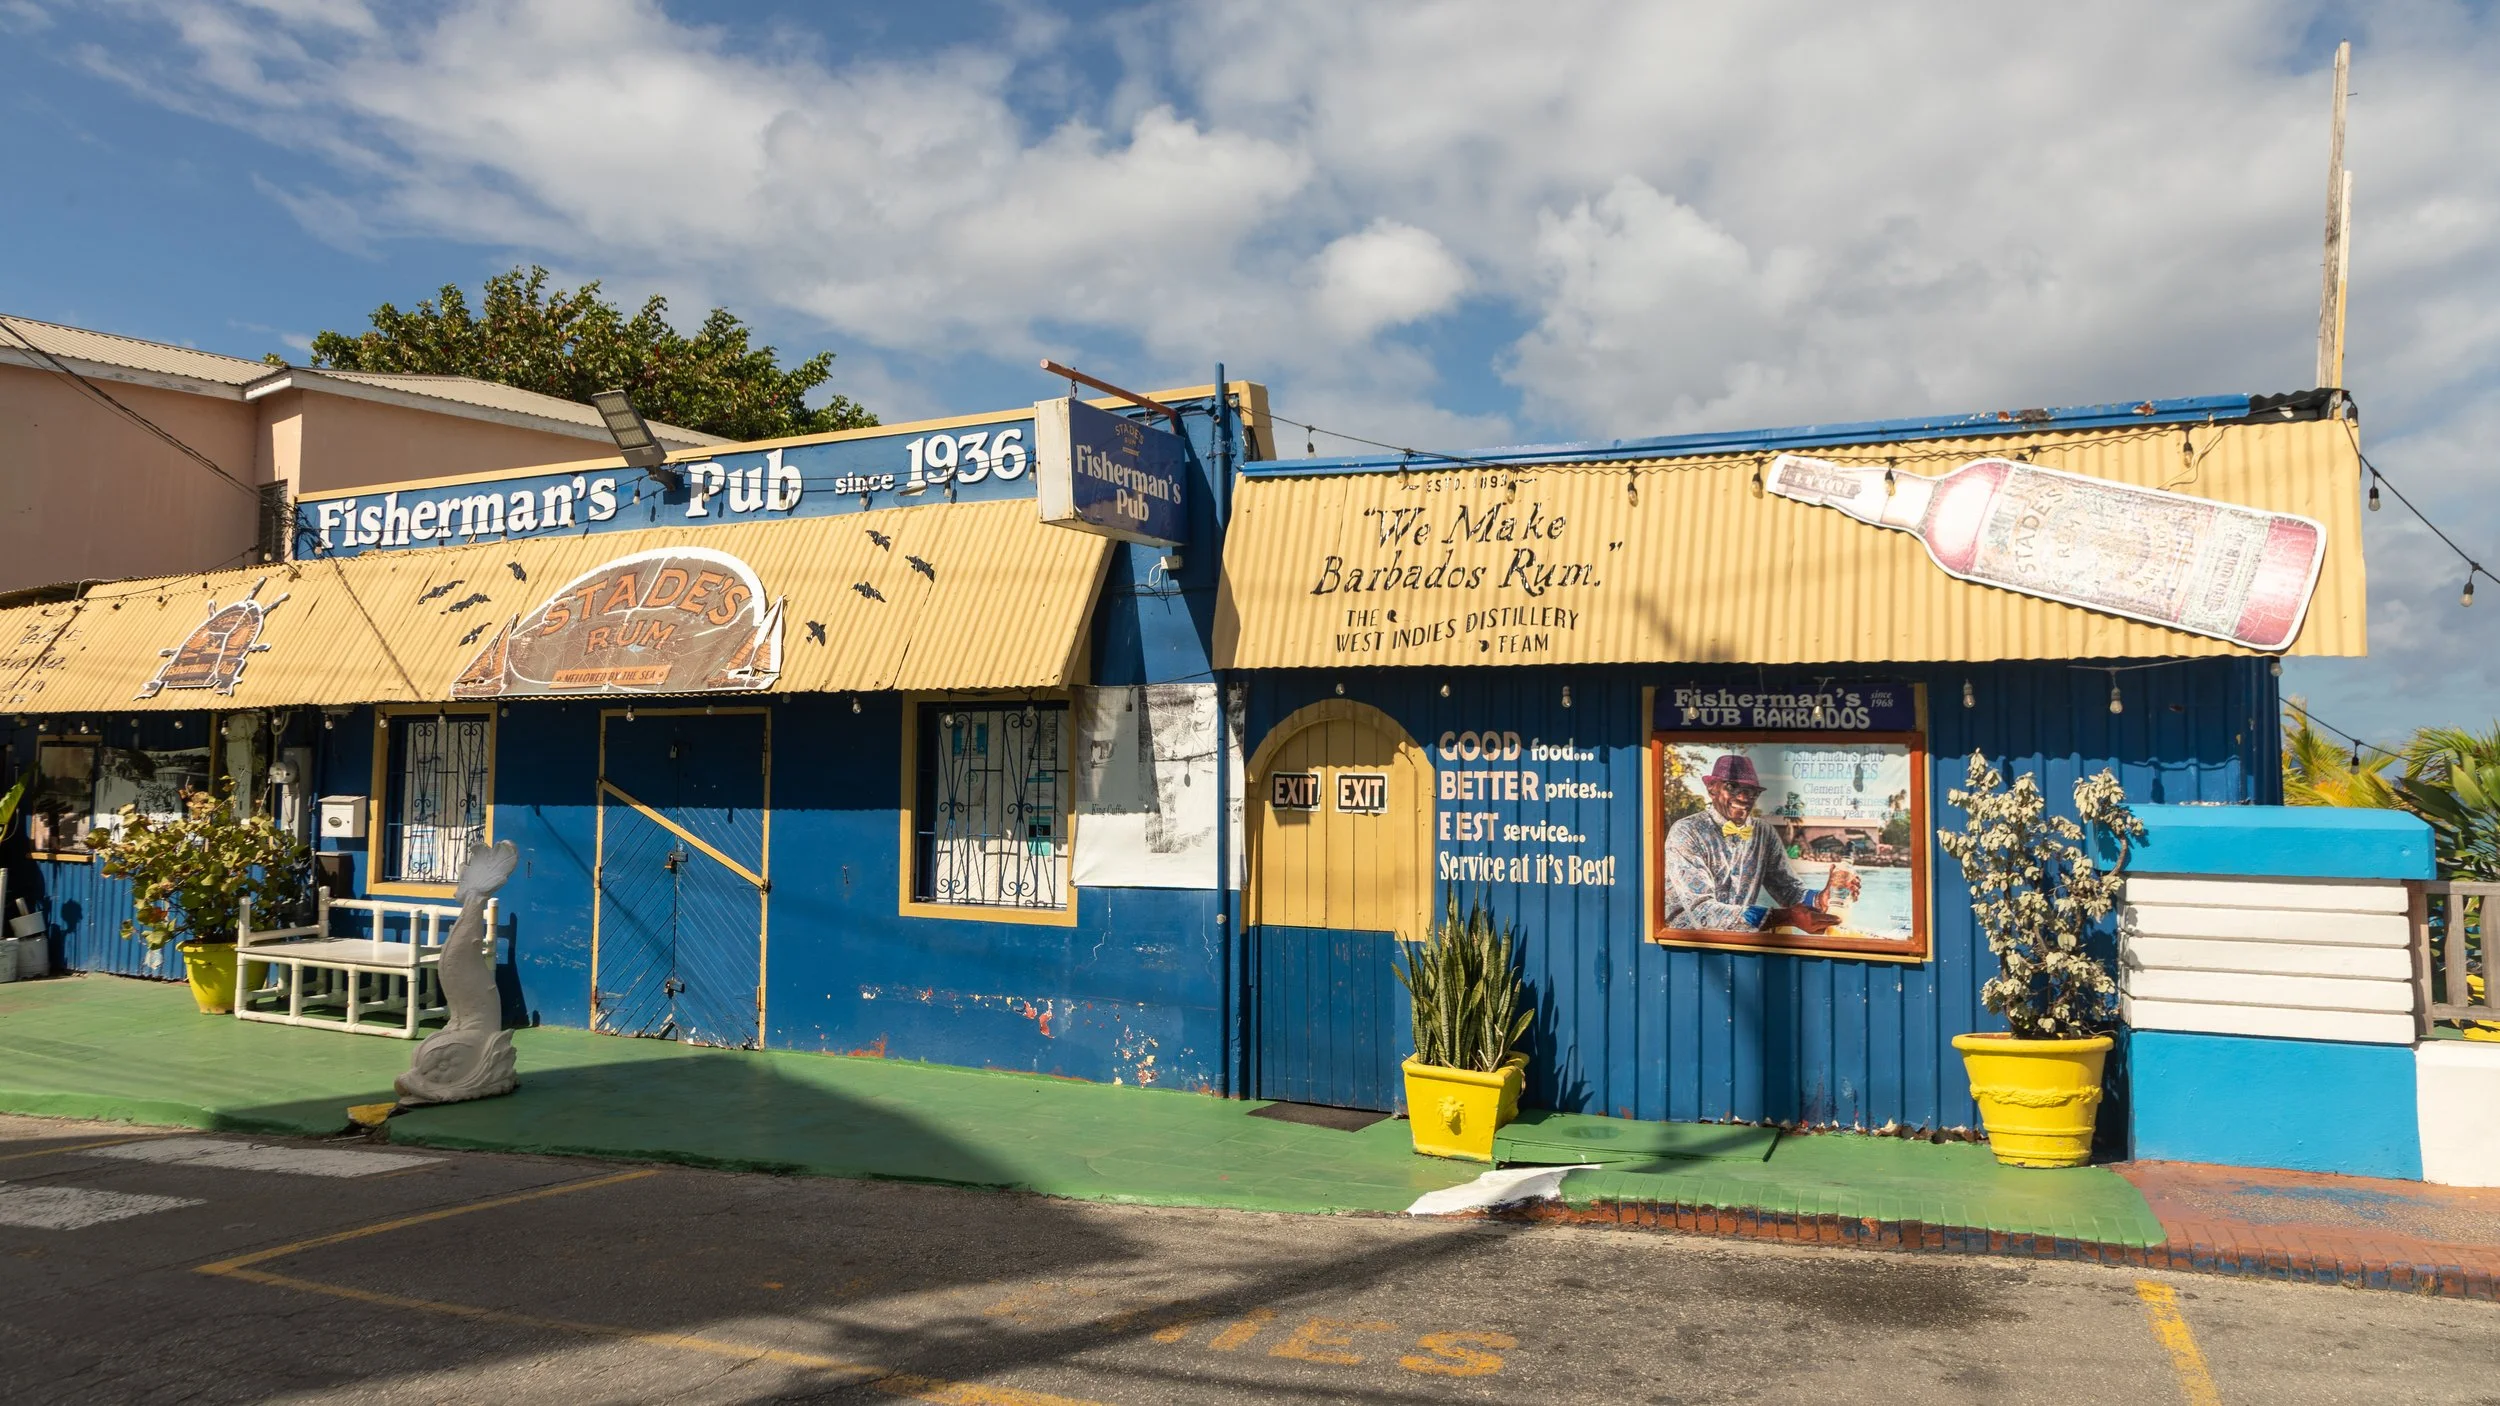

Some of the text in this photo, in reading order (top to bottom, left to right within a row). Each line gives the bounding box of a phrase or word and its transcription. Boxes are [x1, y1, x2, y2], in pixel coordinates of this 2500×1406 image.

[318, 428, 1027, 548] Fisherman's Pub since 1936
[1076, 444, 1181, 504] Fisherman's
[1116, 488, 1149, 521] Pub
[1441, 502, 1567, 544] Make
[1310, 549, 1487, 595] Barbados
[538, 567, 754, 638] STADE'S
[1347, 609, 1380, 627] THE
[585, 618, 678, 655] RUM
[1336, 605, 1579, 653] WEST INDIES DISTILLERY
[1498, 633, 1549, 654] TEAM
[564, 672, 606, 683] MELLOWED
[622, 671, 637, 681] THE
[639, 670, 656, 680] SEA
[1674, 688, 1861, 708] Fisherman's
[1870, 690, 1892, 699] since
[1870, 698, 1893, 708] 1968
[1680, 707, 1870, 729] PUB BARBADOS
[1439, 730, 1522, 762] GOOD
[1275, 777, 1317, 806] EXIT
[1340, 778, 1383, 807] EXIT
[1440, 770, 1614, 802] BETTER prices...
[1503, 819, 1587, 843] service...
[1439, 850, 1615, 885] Service at it's Best!
